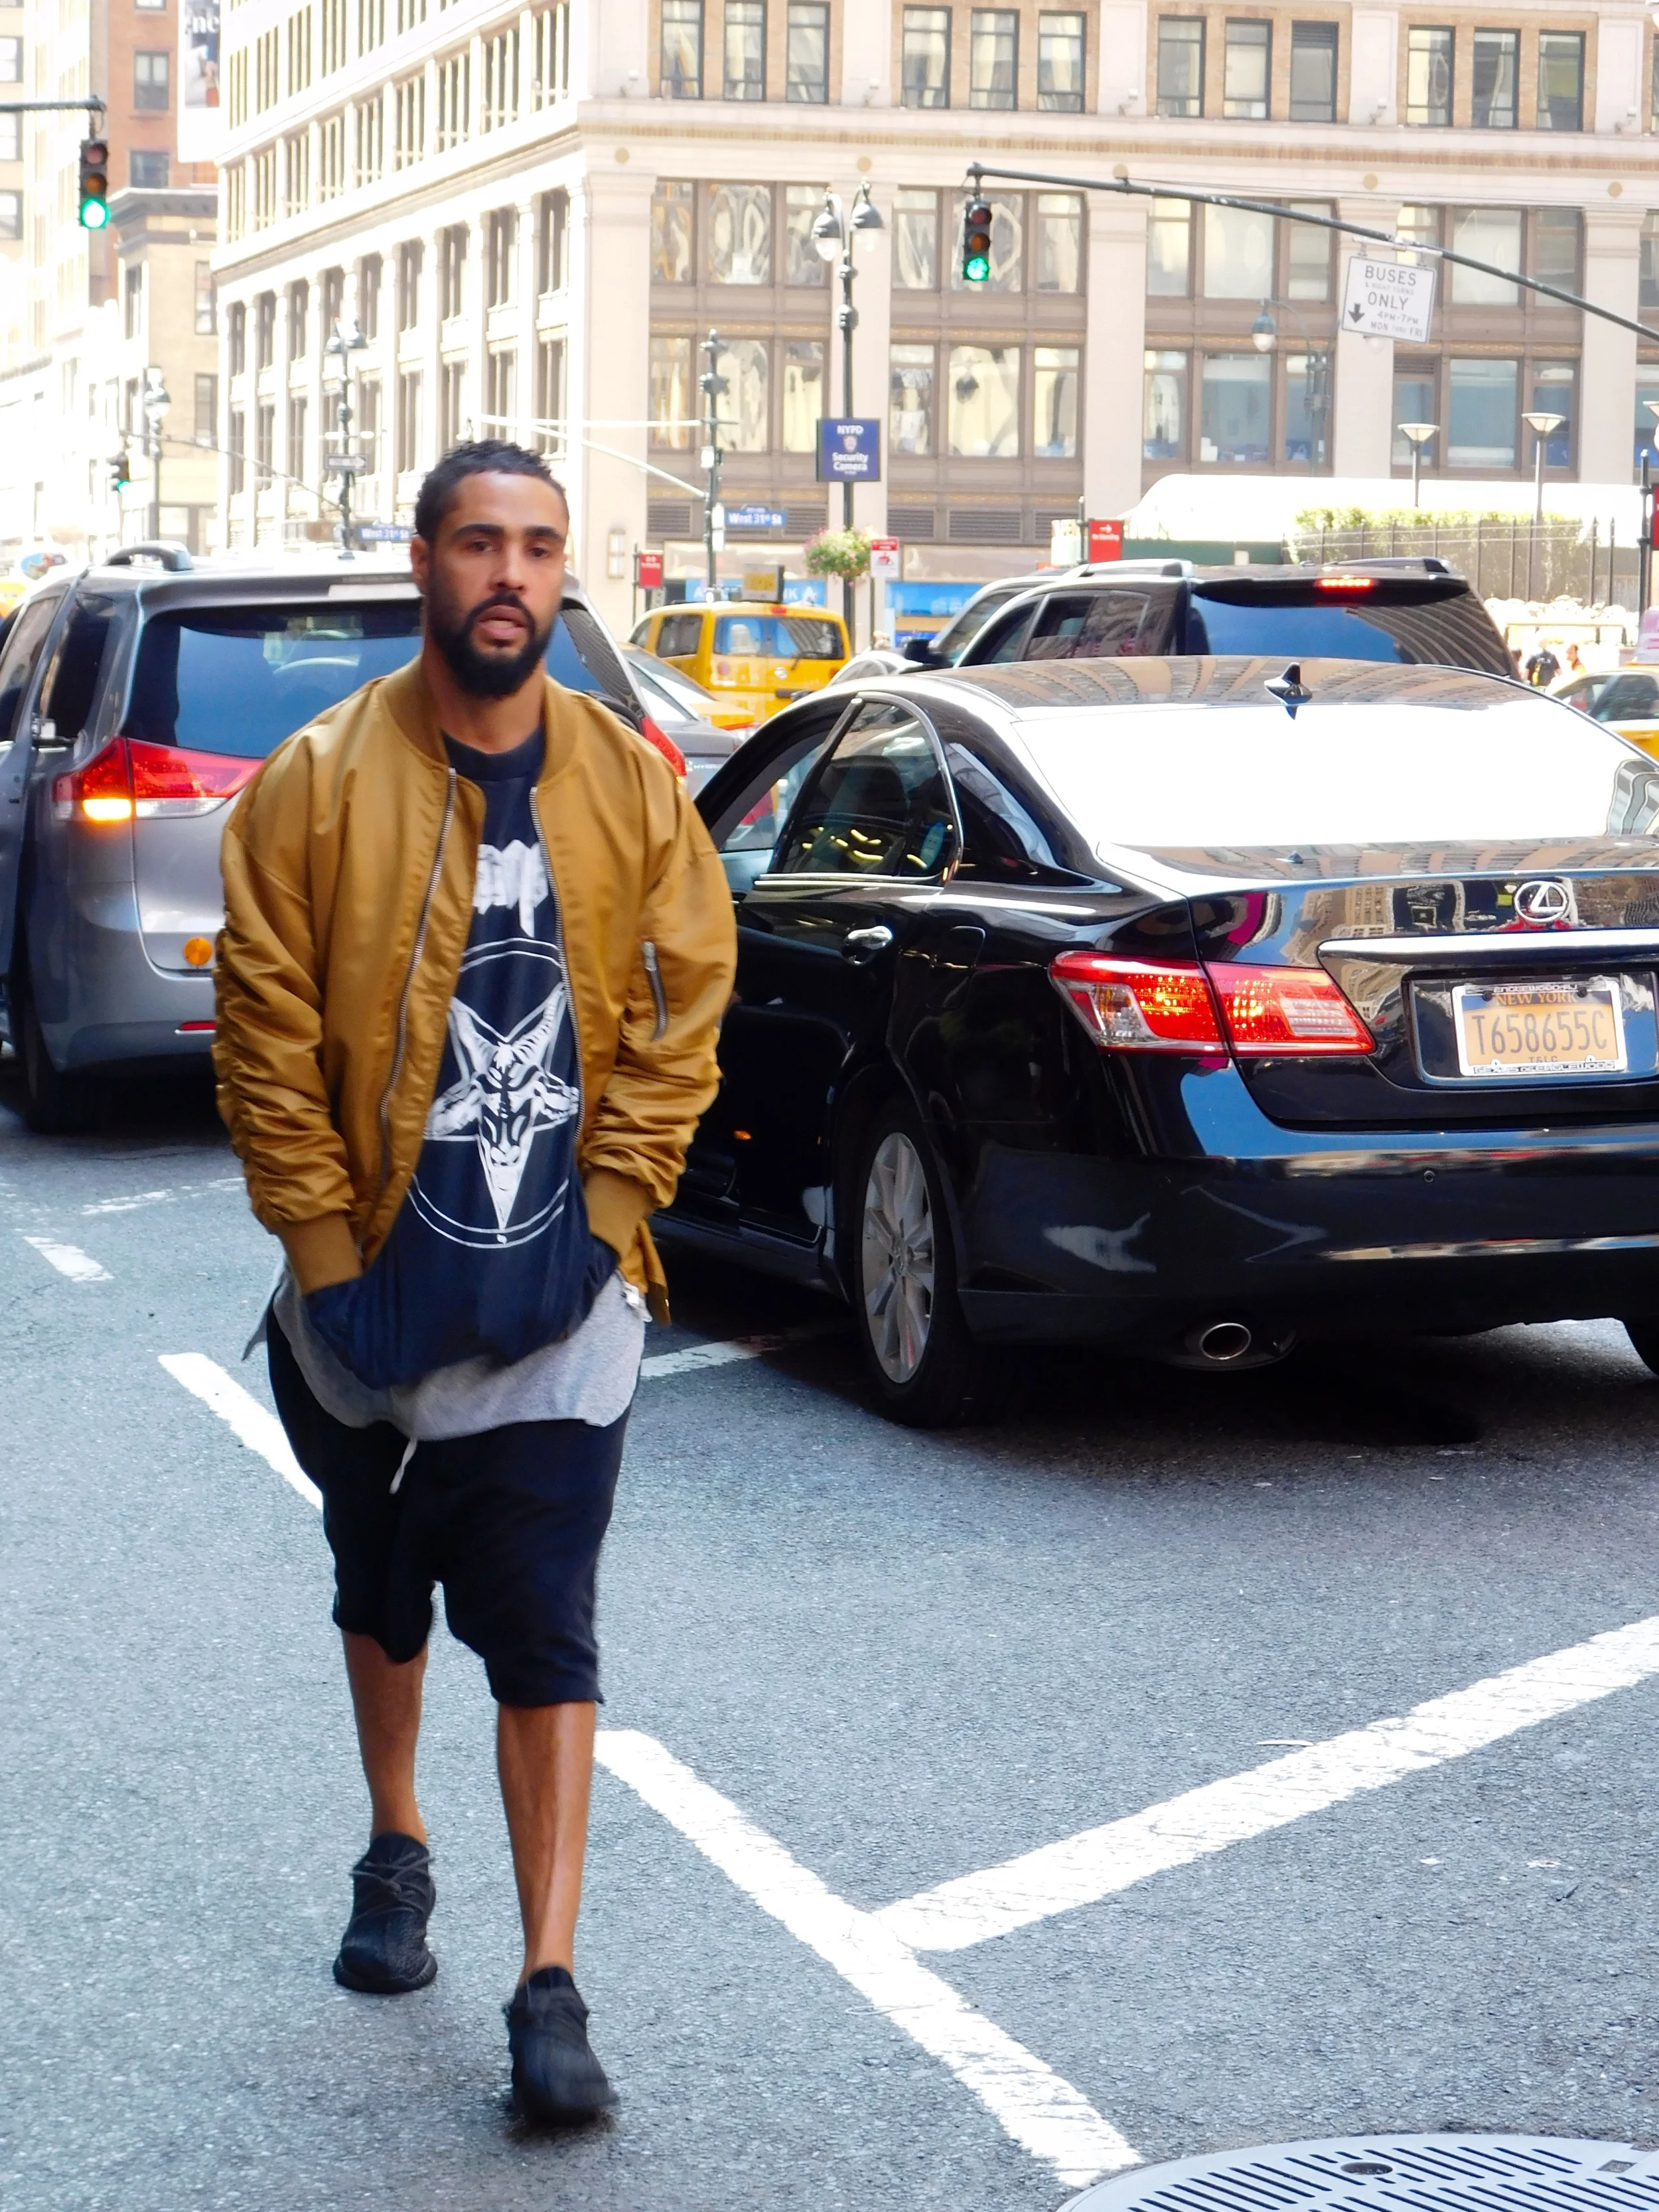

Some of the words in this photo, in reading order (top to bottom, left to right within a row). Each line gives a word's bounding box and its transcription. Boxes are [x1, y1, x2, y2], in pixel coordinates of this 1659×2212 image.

[1365, 265, 1416, 286] BUSES
[1368, 291, 1409, 311] ONLY
[1370, 321, 1388, 331] MON
[1409, 327, 1423, 337] FRI
[837, 425, 864, 435] NYPD
[831, 452, 869, 463] Security
[833, 461, 868, 472] Camera
[728, 512, 753, 524] West
[771, 513, 782, 526] St
[1494, 992, 1533, 1005] NEW
[1537, 992, 1578, 1003] YORK
[1471, 1010, 1607, 1055] T658655C
